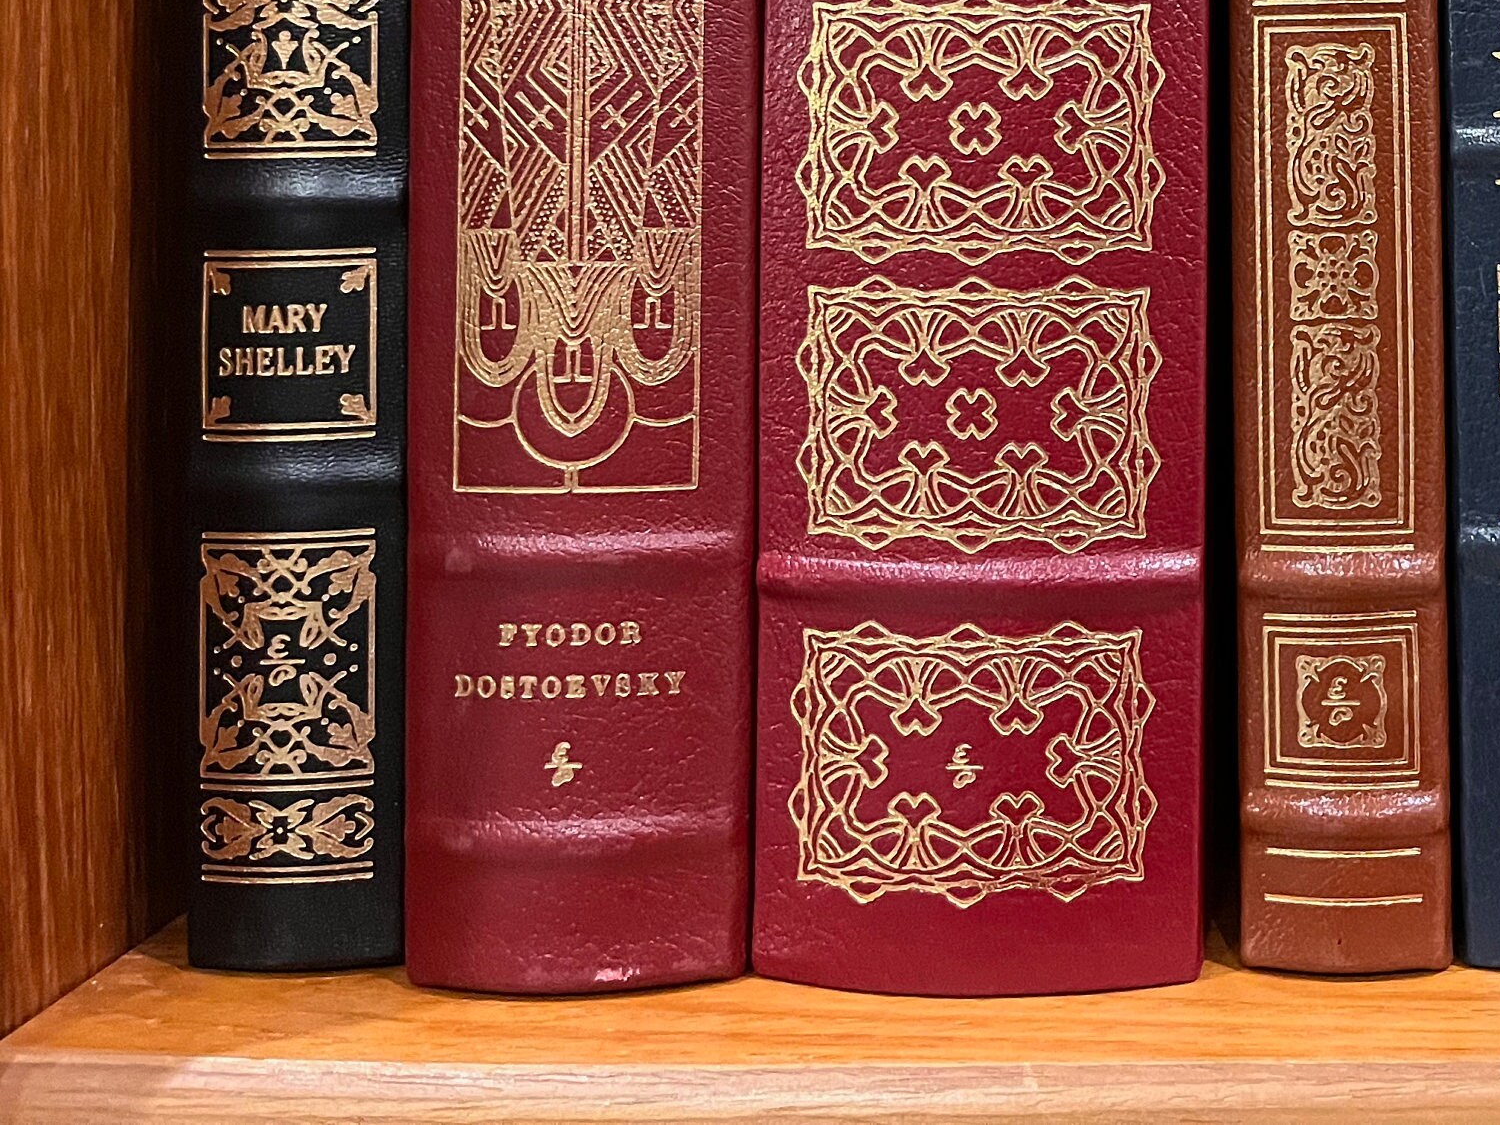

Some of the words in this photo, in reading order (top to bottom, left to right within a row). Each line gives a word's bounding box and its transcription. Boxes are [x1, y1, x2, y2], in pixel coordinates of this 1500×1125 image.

[242, 304, 328, 334] MARY
[218, 344, 356, 377] SHELLEY
[498, 622, 643, 648] FYODOR
[454, 670, 687, 700] DOSTOEVSKY
